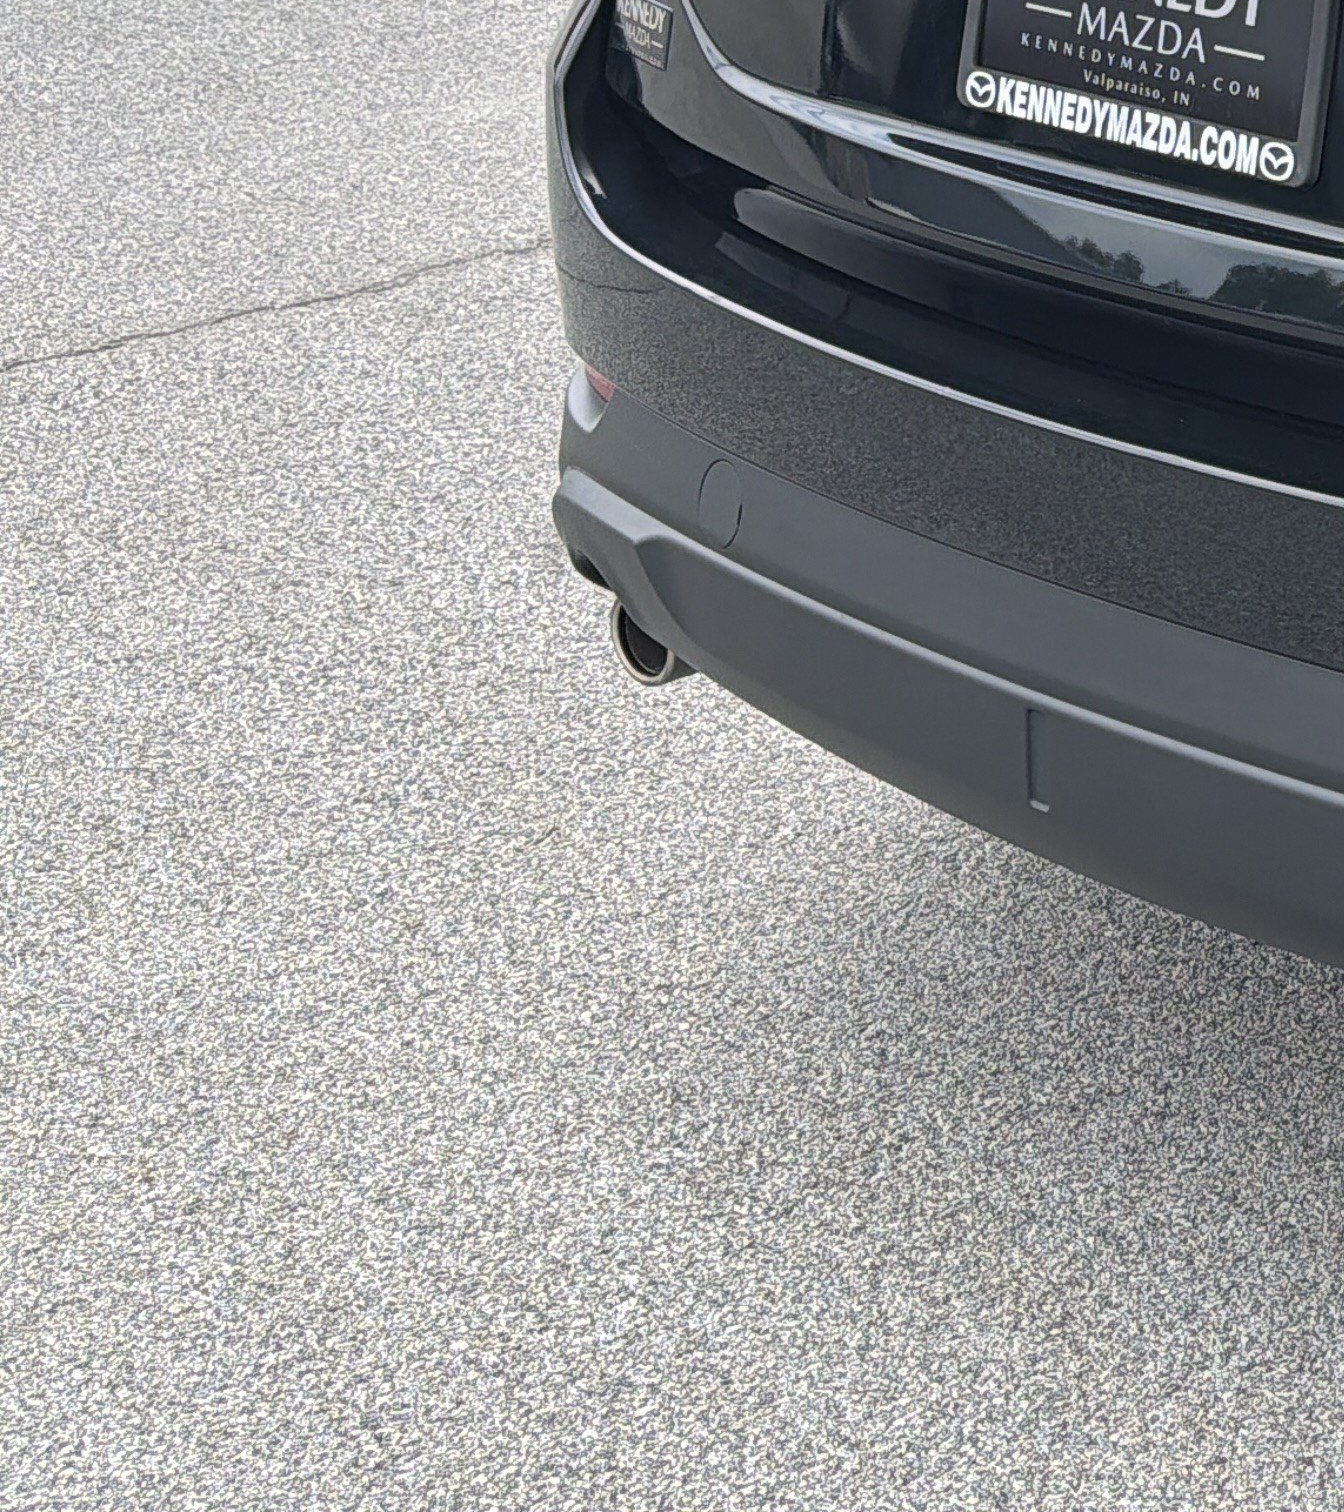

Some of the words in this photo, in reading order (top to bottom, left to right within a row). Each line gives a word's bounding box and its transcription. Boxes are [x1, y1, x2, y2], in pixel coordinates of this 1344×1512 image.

[1076, 2, 1206, 63] MAZDA
[1021, 32, 1260, 101] KENNEDYMAZDA.COM
[1083, 69, 1167, 103] Valparaiso,
[1173, 90, 1191, 106] IN
[996, 76, 1259, 176] KENNEDYMAZDA.COM
